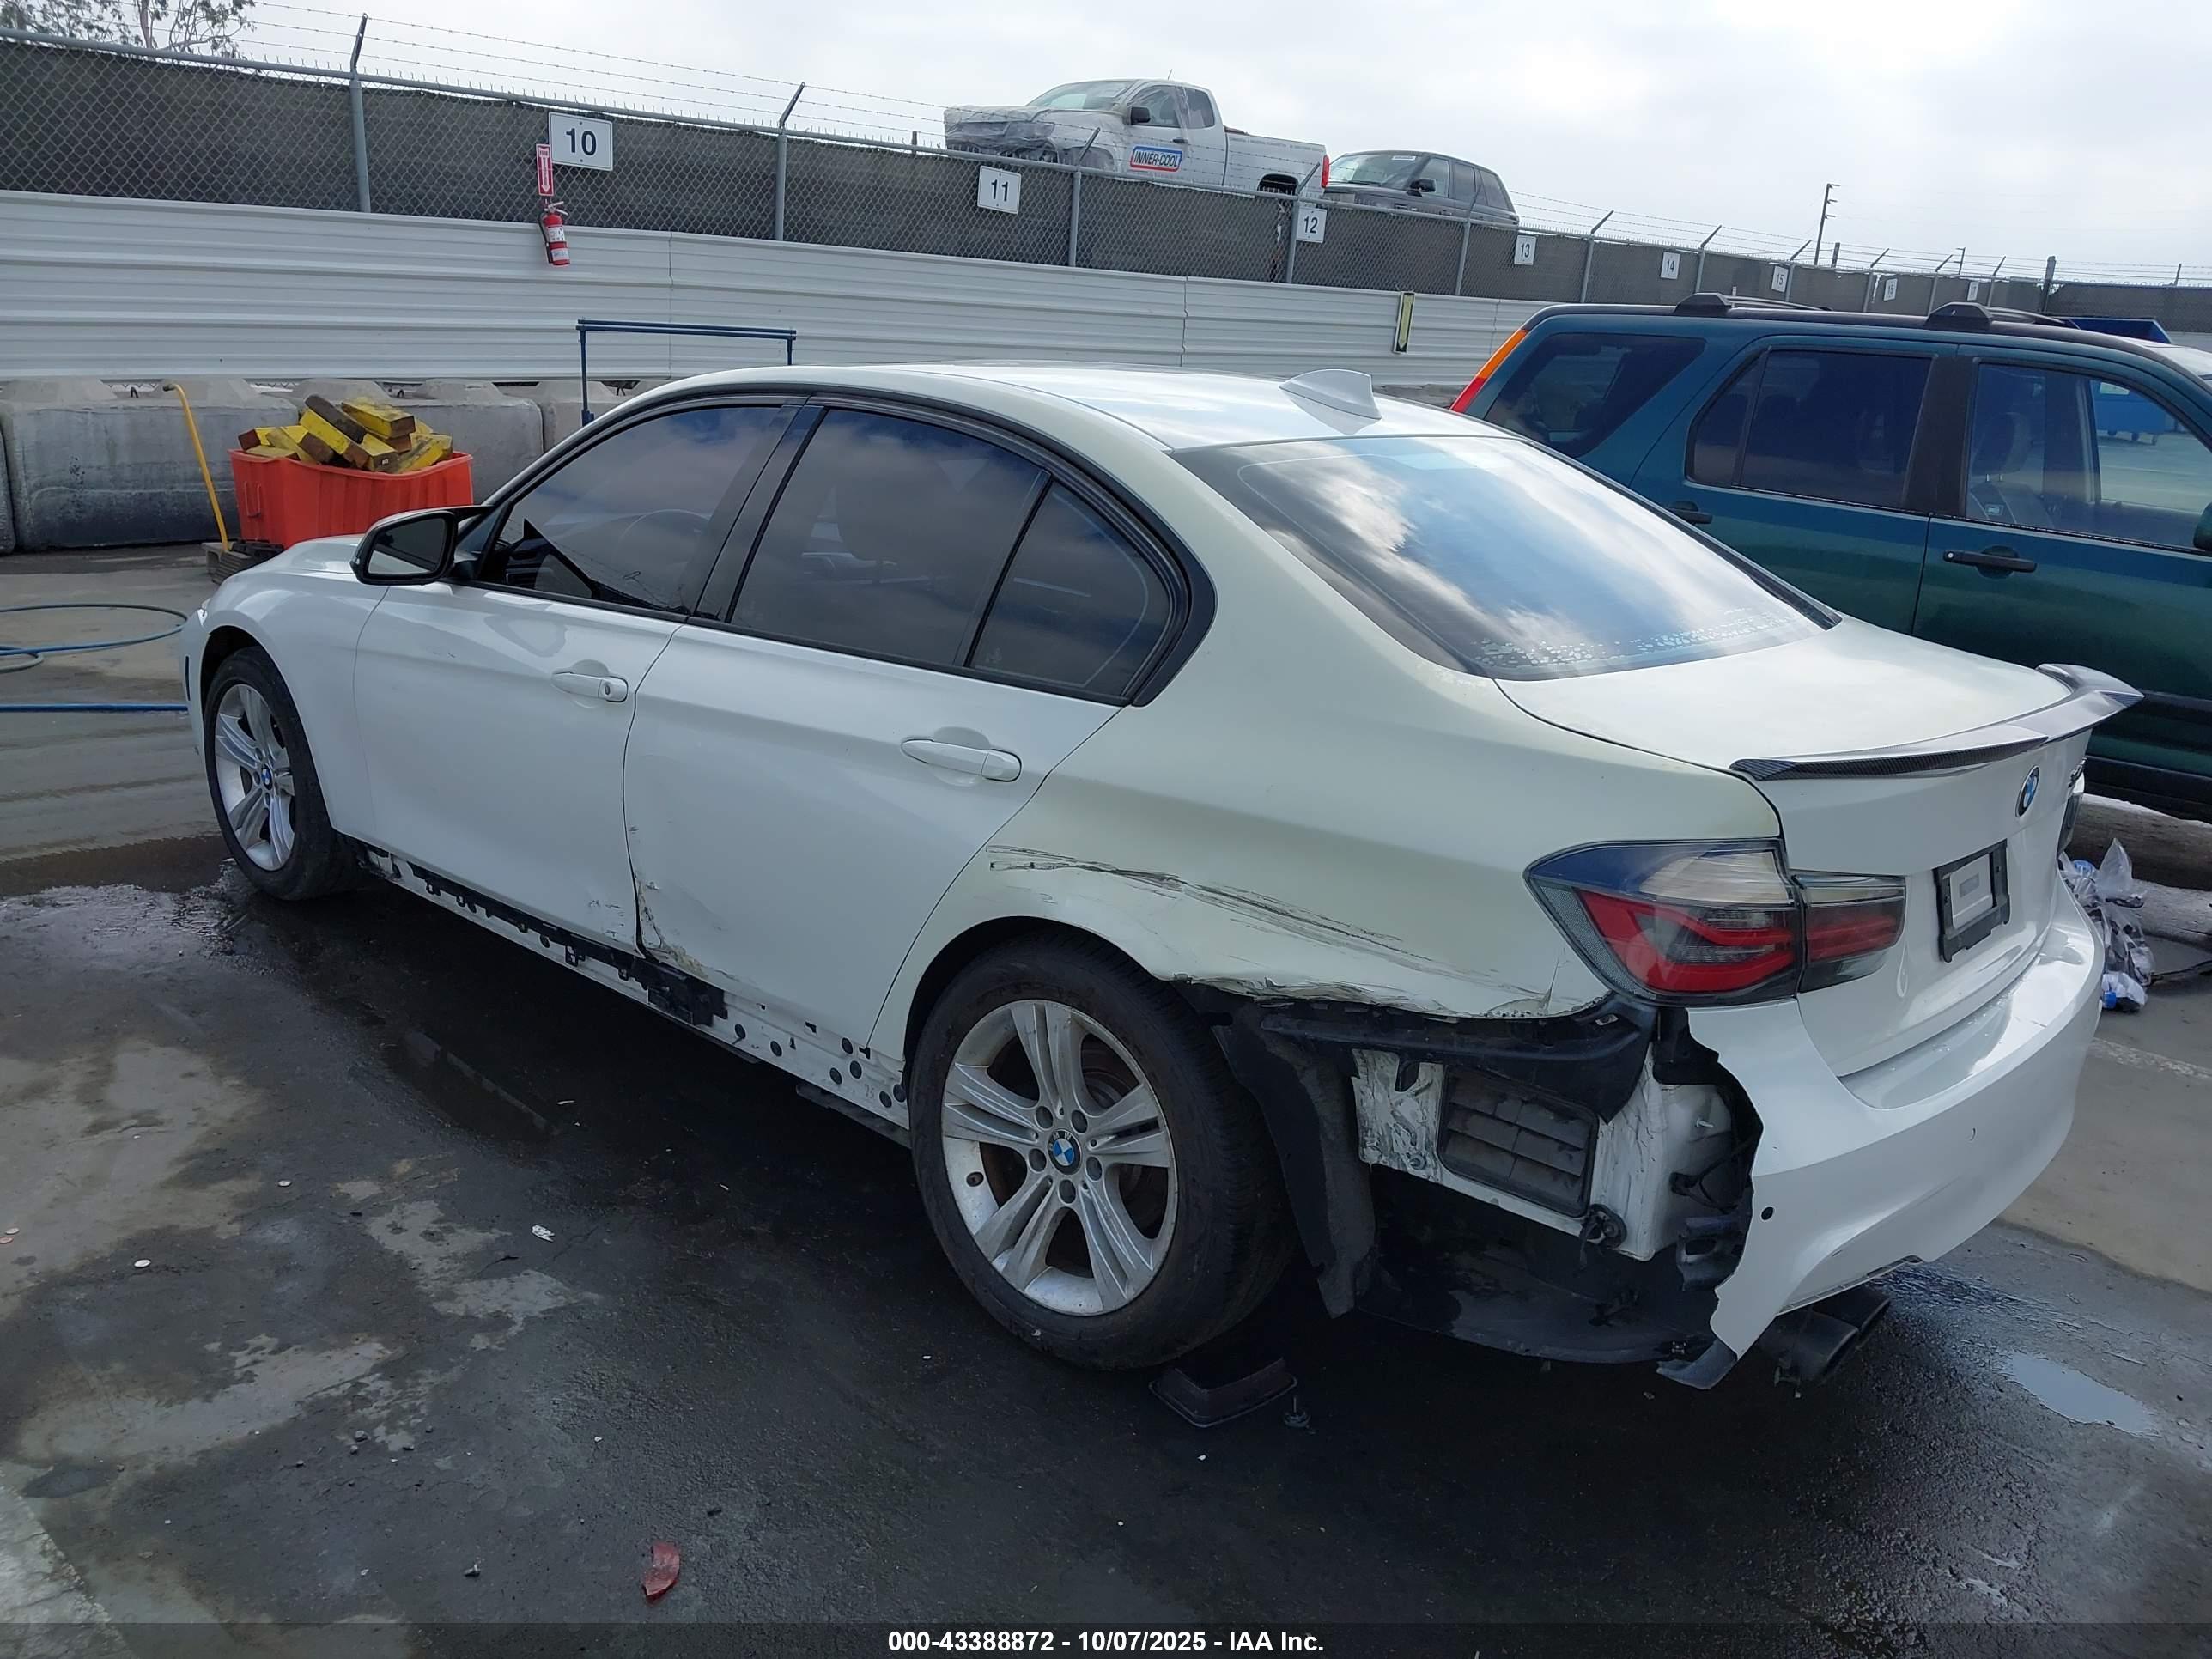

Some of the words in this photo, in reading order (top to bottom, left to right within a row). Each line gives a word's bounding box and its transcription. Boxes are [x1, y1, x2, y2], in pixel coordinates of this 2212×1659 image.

[566, 128, 597, 156] 10
[1133, 150, 1179, 167] INNER-COOL
[991, 179, 1009, 202] 11
[1304, 216, 1318, 234] 12
[1521, 243, 1530, 258] 13
[1667, 259, 1674, 272] 14
[1777, 273, 1784, 285] 15
